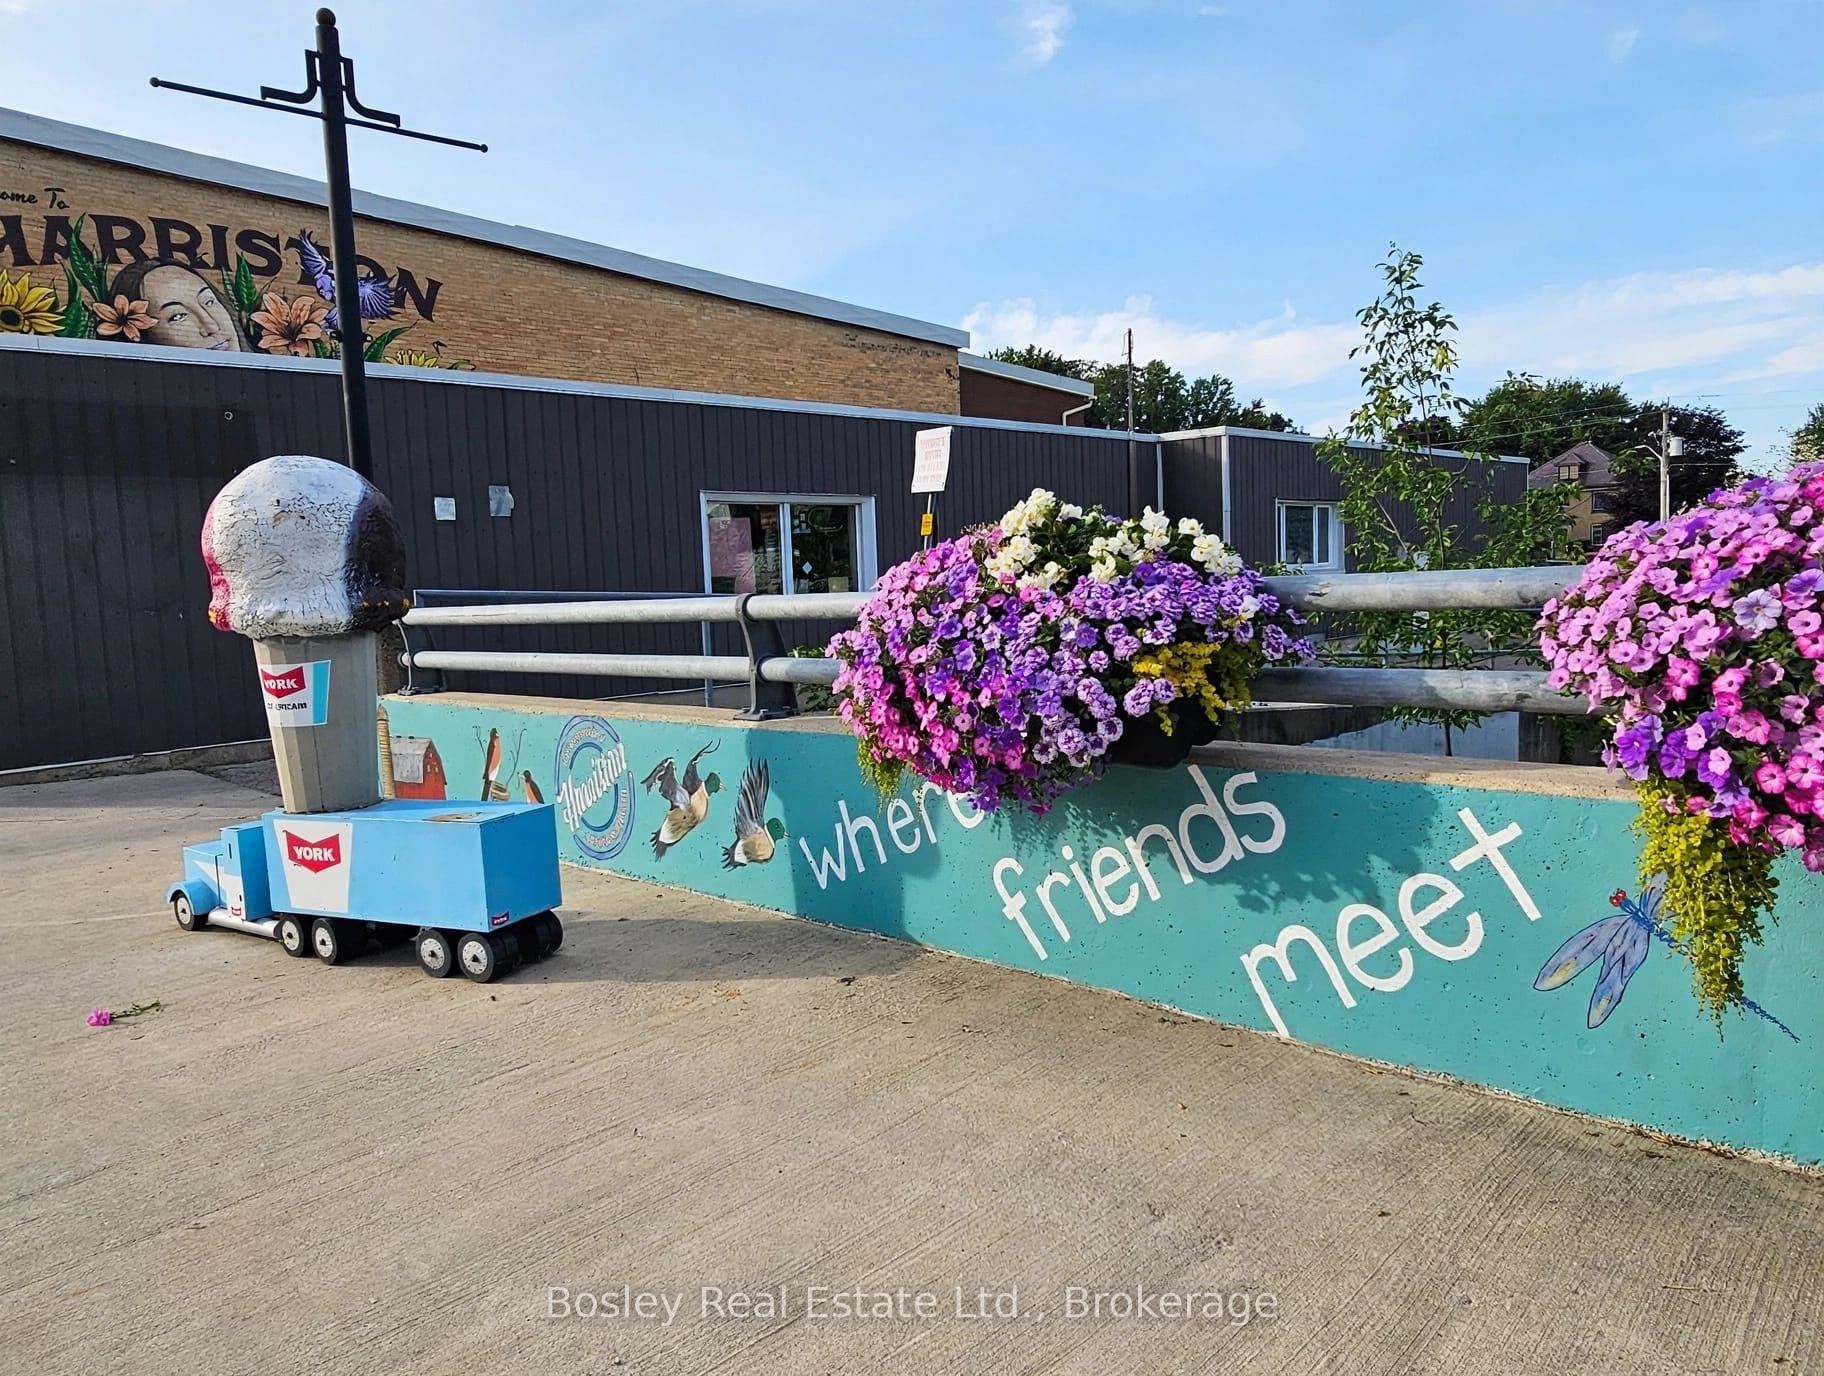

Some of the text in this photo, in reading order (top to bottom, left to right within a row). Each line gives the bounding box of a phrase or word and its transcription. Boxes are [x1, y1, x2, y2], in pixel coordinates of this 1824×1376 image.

[44, 187, 70, 209] To
[263, 678, 299, 690] YORK
[292, 845, 336, 862] YORK
[799, 780, 985, 890] where
[992, 764, 1287, 961] friends
[1240, 806, 1542, 1038] meet
